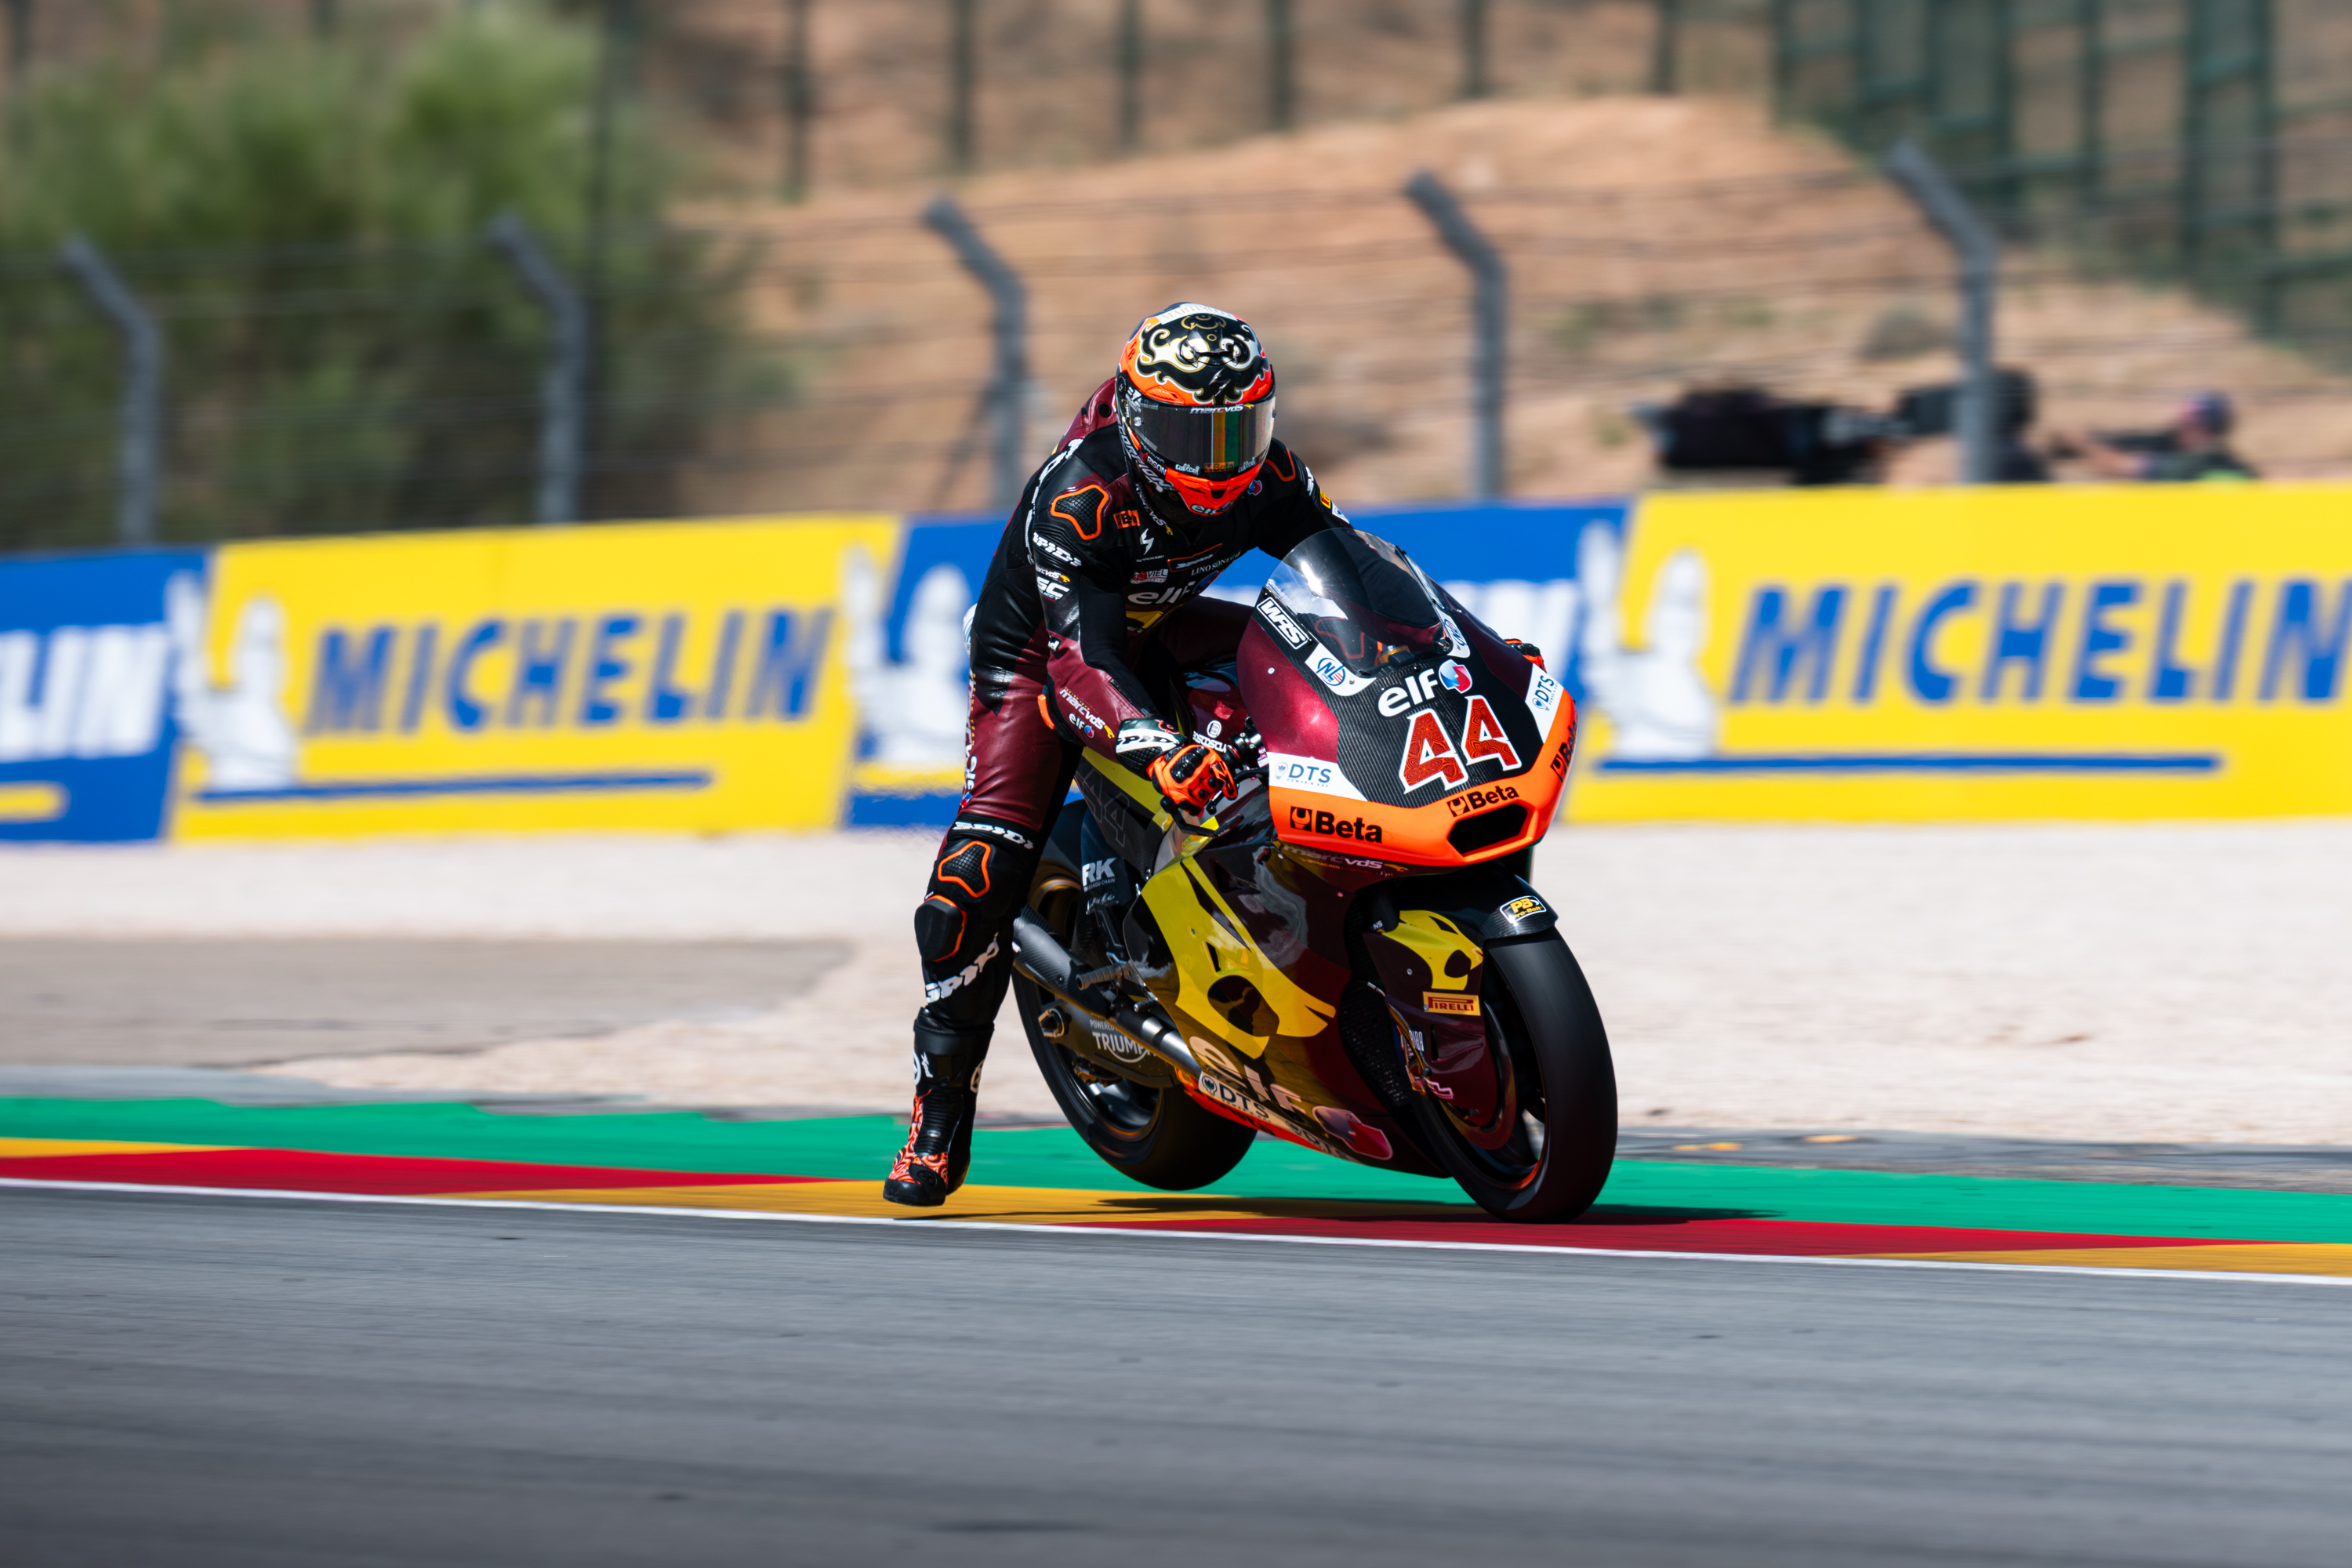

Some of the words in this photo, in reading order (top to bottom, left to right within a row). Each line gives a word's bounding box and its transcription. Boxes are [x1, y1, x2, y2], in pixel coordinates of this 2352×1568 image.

[1191, 564, 1211, 576] LINO
[1260, 600, 1306, 643] WRS
[1729, 578, 2352, 702] MICHELIN
[306, 608, 835, 733] MICHELIN
[1378, 670, 1438, 717] elf
[1534, 675, 1555, 702] DTS
[1069, 713, 1085, 730] elf
[1399, 695, 1523, 795] 44
[1288, 764, 1332, 783] DTS
[1467, 786, 1519, 810] Beta
[1316, 811, 1383, 844] Beta
[1083, 857, 1117, 887] RK
[1510, 898, 1534, 913] PB
[1428, 996, 1475, 1011] PIRELLI
[1189, 1036, 1306, 1114] elf
[1219, 1083, 1269, 1119] DTS
